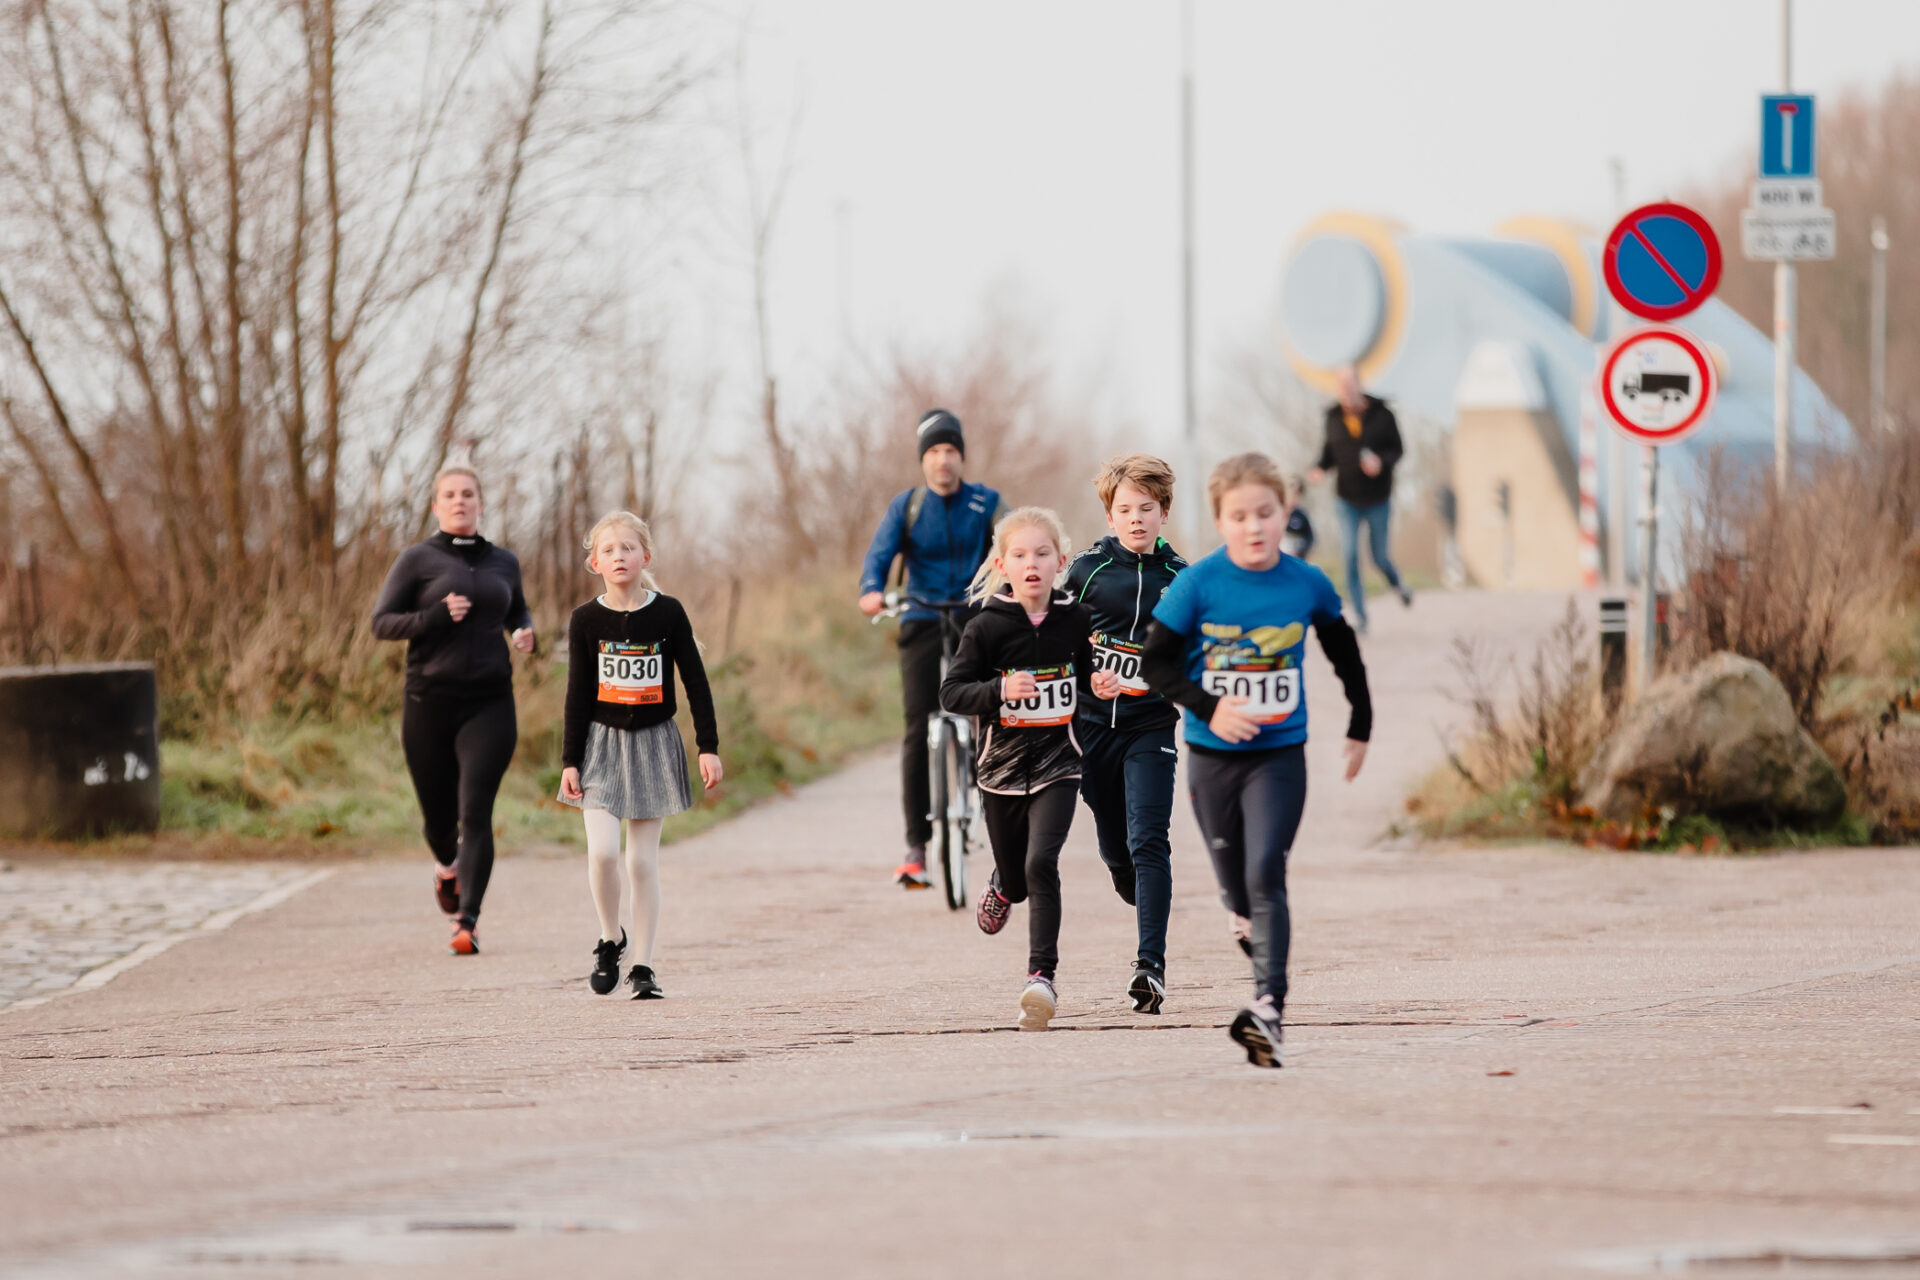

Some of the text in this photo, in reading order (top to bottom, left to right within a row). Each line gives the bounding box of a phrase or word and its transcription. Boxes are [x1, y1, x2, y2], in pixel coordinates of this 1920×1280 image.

[603, 656, 658, 680] 5030
[1093, 648, 1141, 680] 500
[640, 693, 659, 702] 5030
[1213, 675, 1290, 704] 5016
